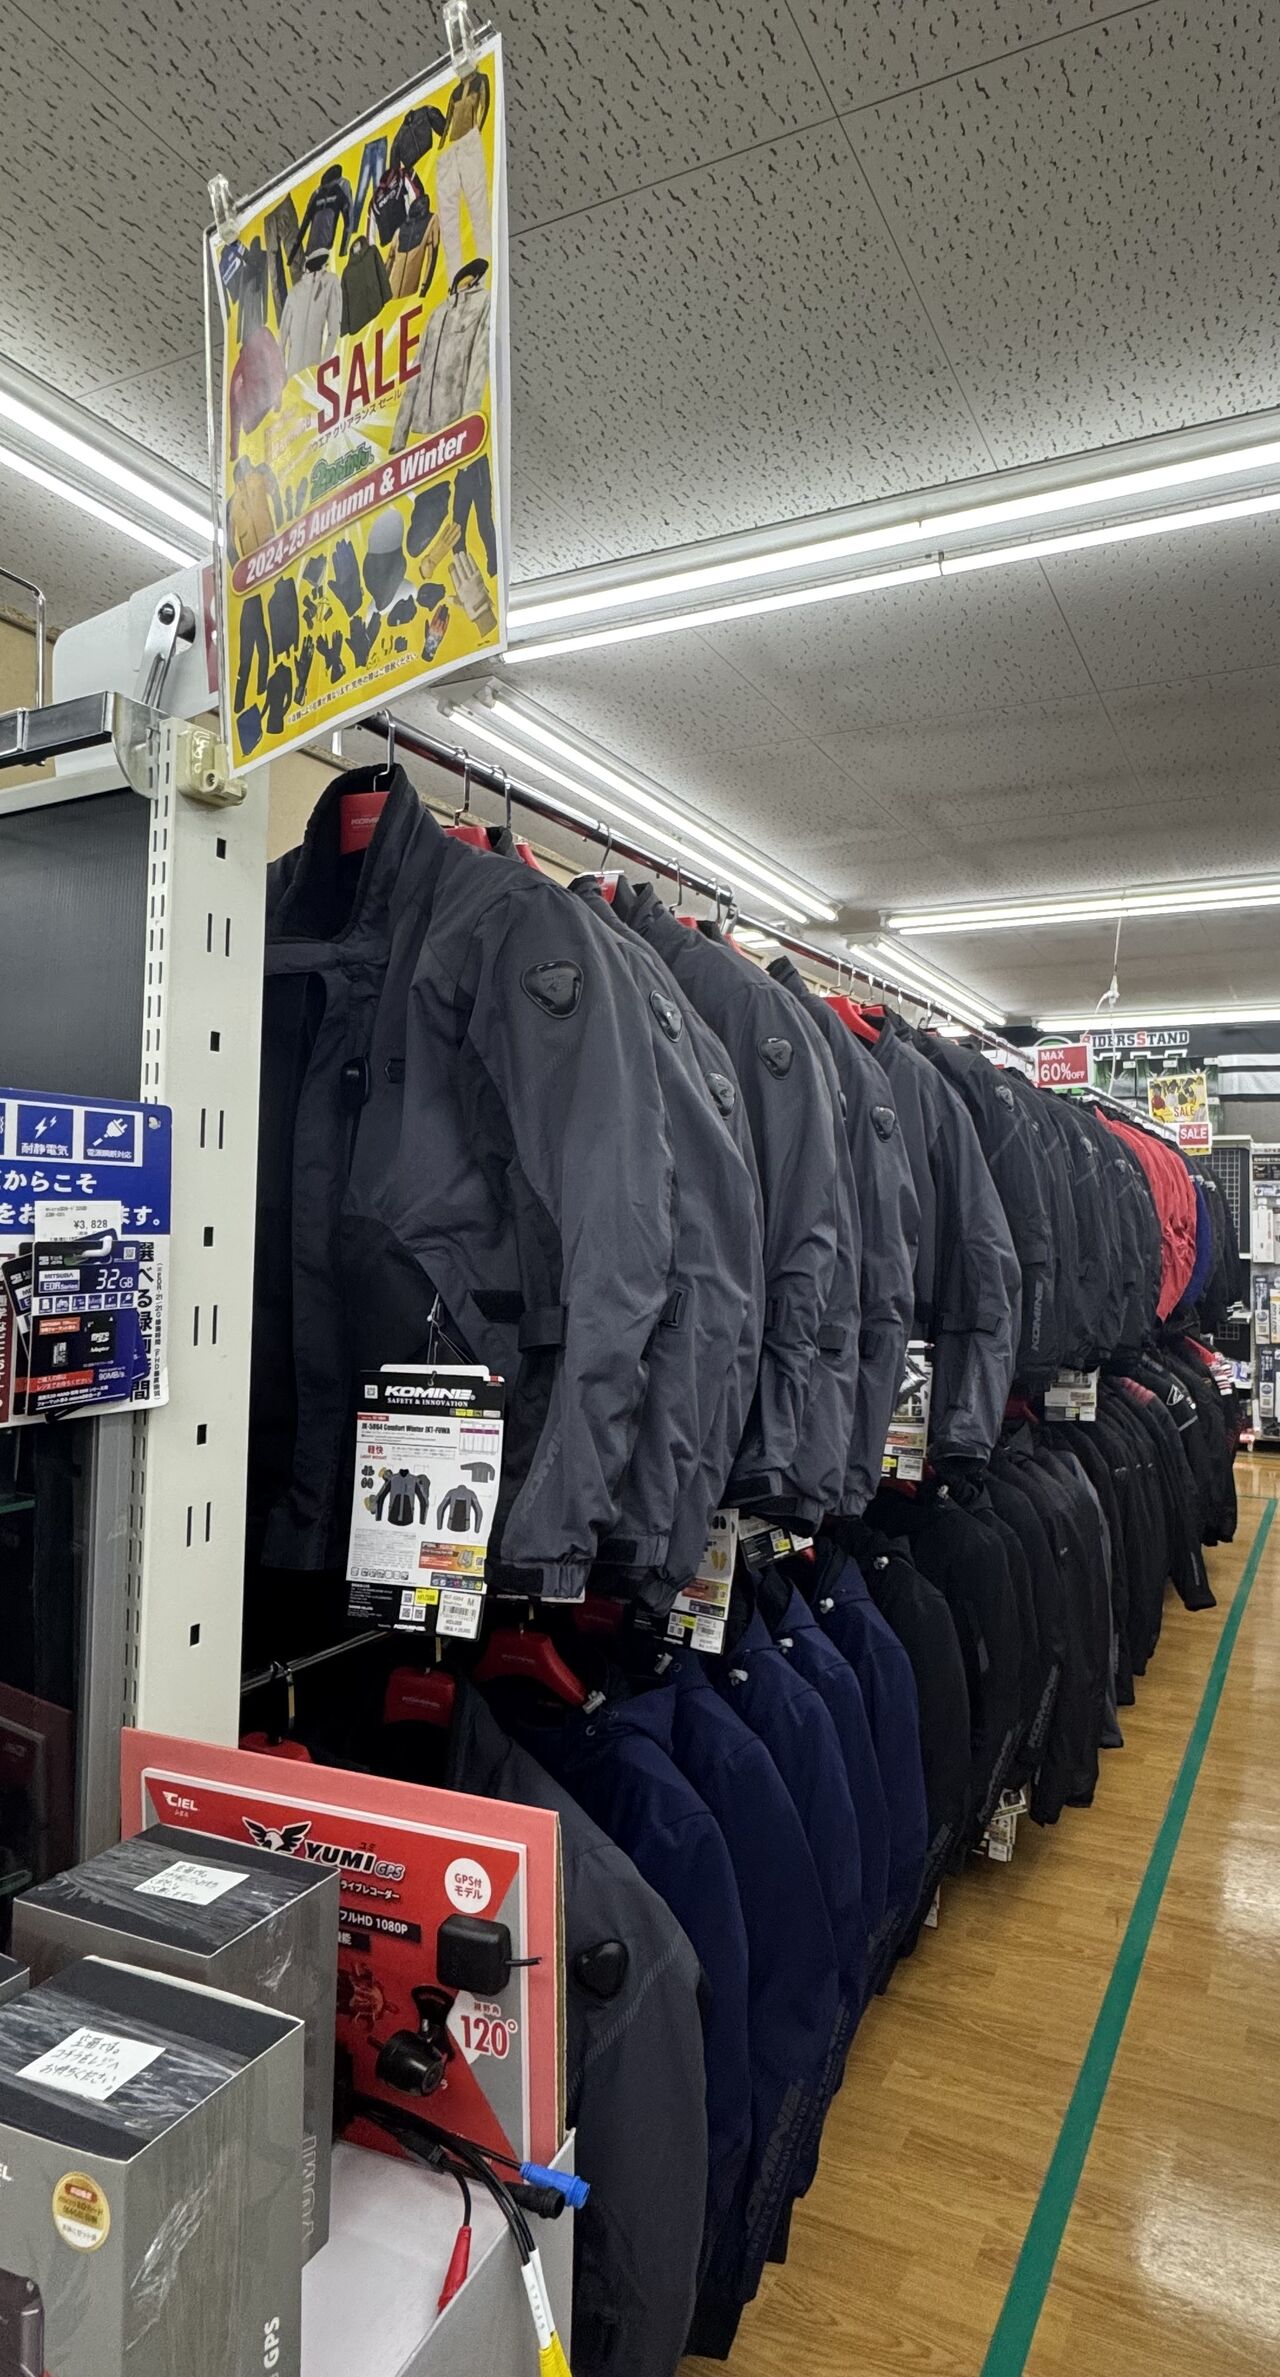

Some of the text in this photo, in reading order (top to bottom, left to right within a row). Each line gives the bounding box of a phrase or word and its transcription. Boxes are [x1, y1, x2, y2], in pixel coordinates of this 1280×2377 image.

[317, 305, 423, 435] SALE
[245, 428, 468, 584] 2024-25 Autumn & Winter
[1041, 1051, 1064, 1061] MAX
[1174, 1105, 1195, 1117] SALE
[1180, 1124, 1207, 1140] SALE
[21, 1142, 69, 1157] 耐静電気
[0, 1170, 97, 1194] からこそ
[74, 1219, 108, 1229] ¥3,828
[385, 1385, 472, 1400] KOMINE
[387, 1397, 414, 1405] SAFETY
[306, 1843, 404, 1880] YUMI GPS
[454, 1873, 483, 1888] GPS付
[453, 1886, 483, 1900] モデル
[376, 1917, 409, 1934] 1080P
[263, 2316, 280, 2370] GPS
